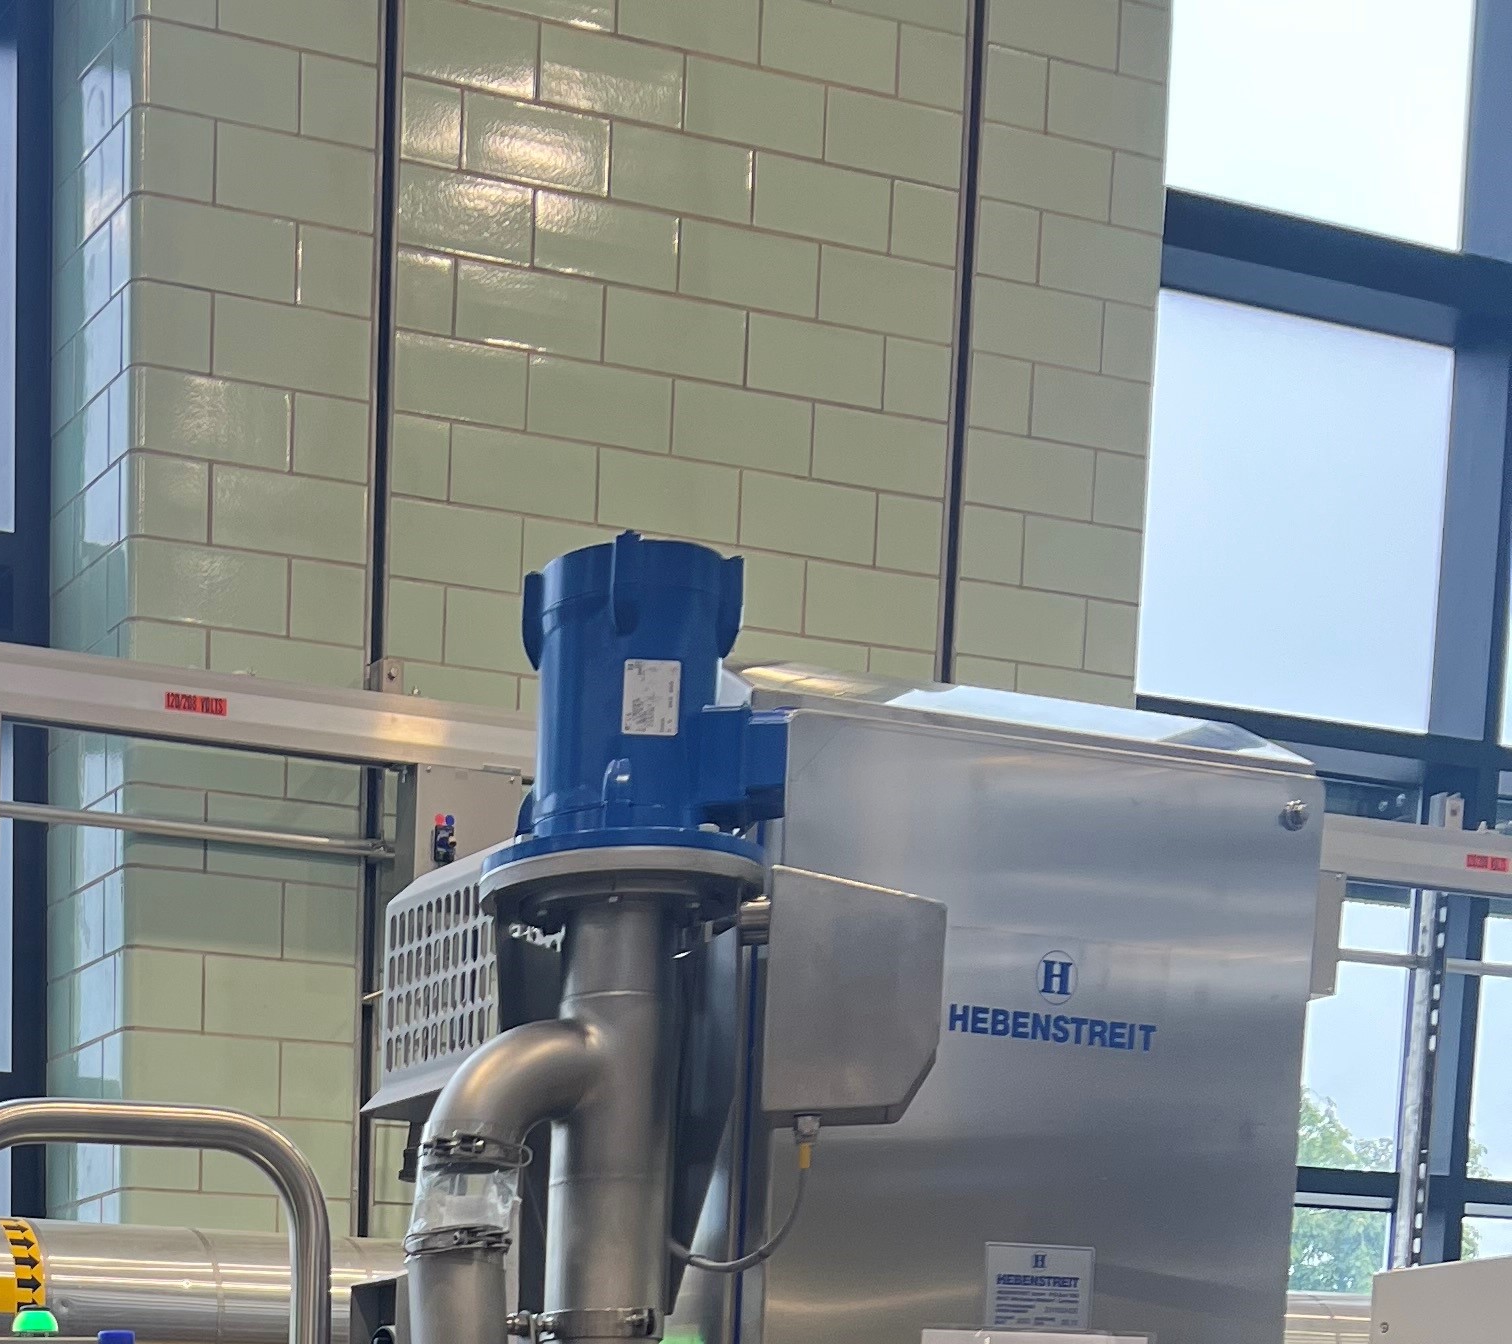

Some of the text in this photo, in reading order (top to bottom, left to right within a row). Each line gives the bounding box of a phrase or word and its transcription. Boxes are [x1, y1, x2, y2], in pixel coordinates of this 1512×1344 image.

[201, 696, 224, 715] VOLTS
[1040, 959, 1073, 996] H
[948, 1003, 1157, 1052] HEBENSTREIT
[996, 1273, 1080, 1288] HEBENSTREIT
